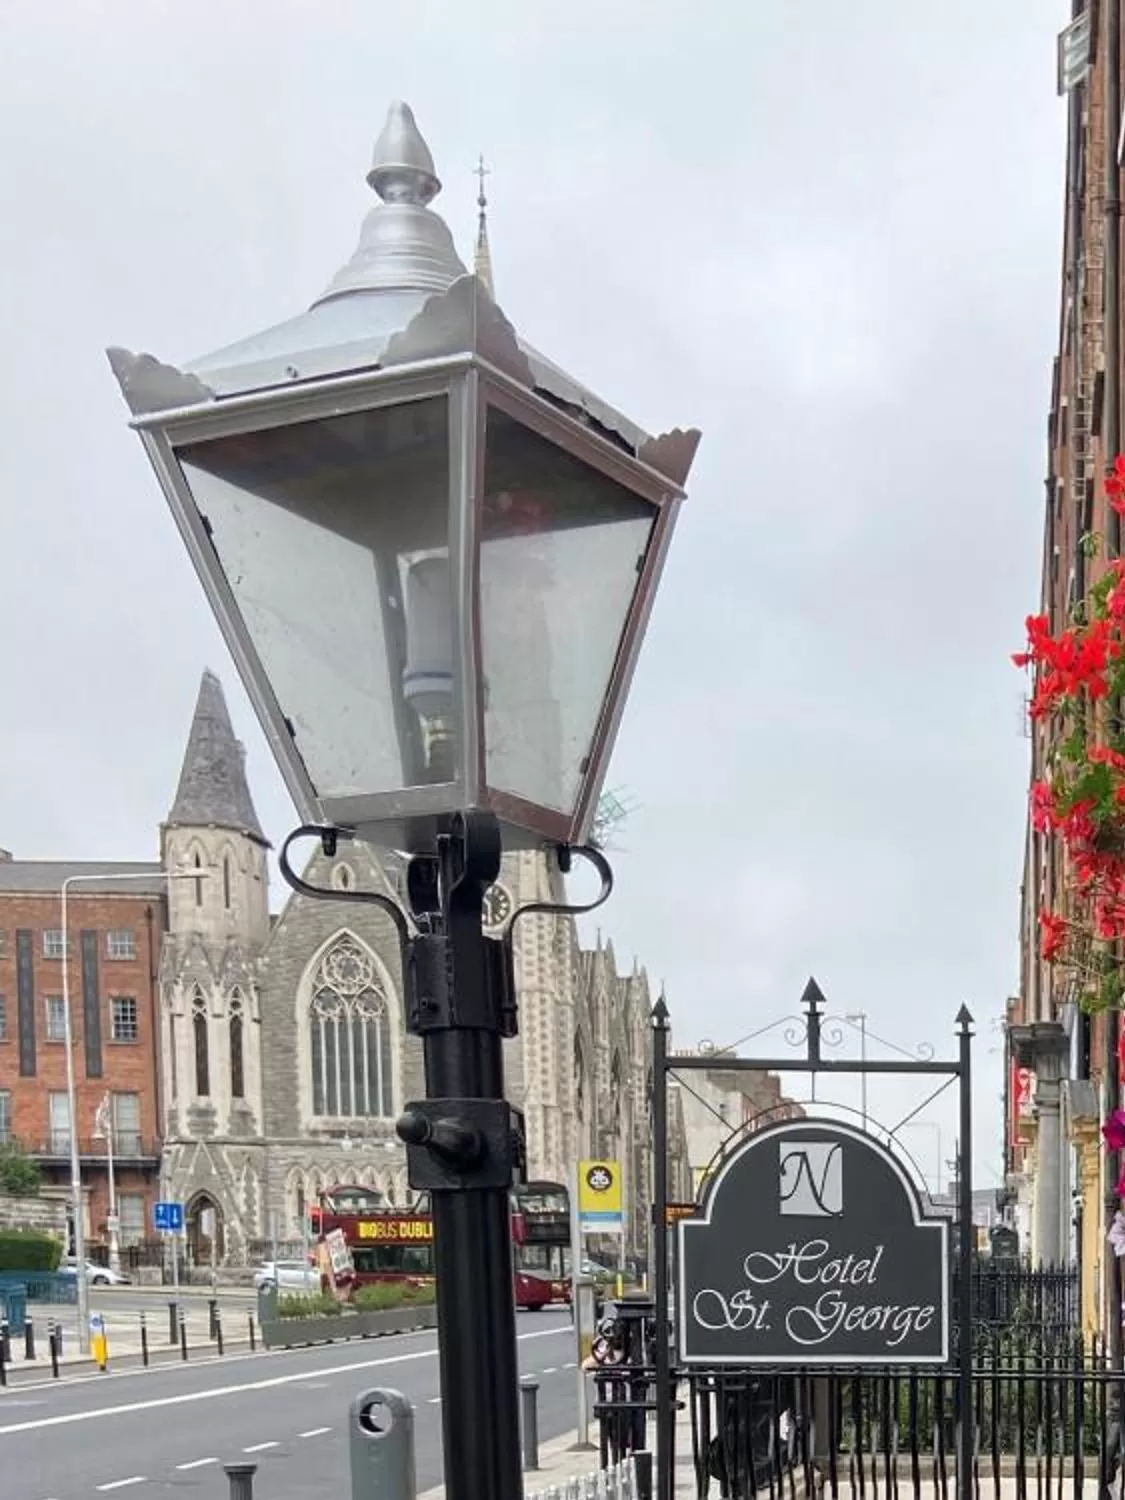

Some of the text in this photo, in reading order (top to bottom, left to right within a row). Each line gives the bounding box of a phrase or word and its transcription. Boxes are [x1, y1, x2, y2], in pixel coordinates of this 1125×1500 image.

[399, 1221, 433, 1239] DUBLI
[744, 1239, 883, 1284] Hotel
[693, 1289, 935, 1346] St. George
